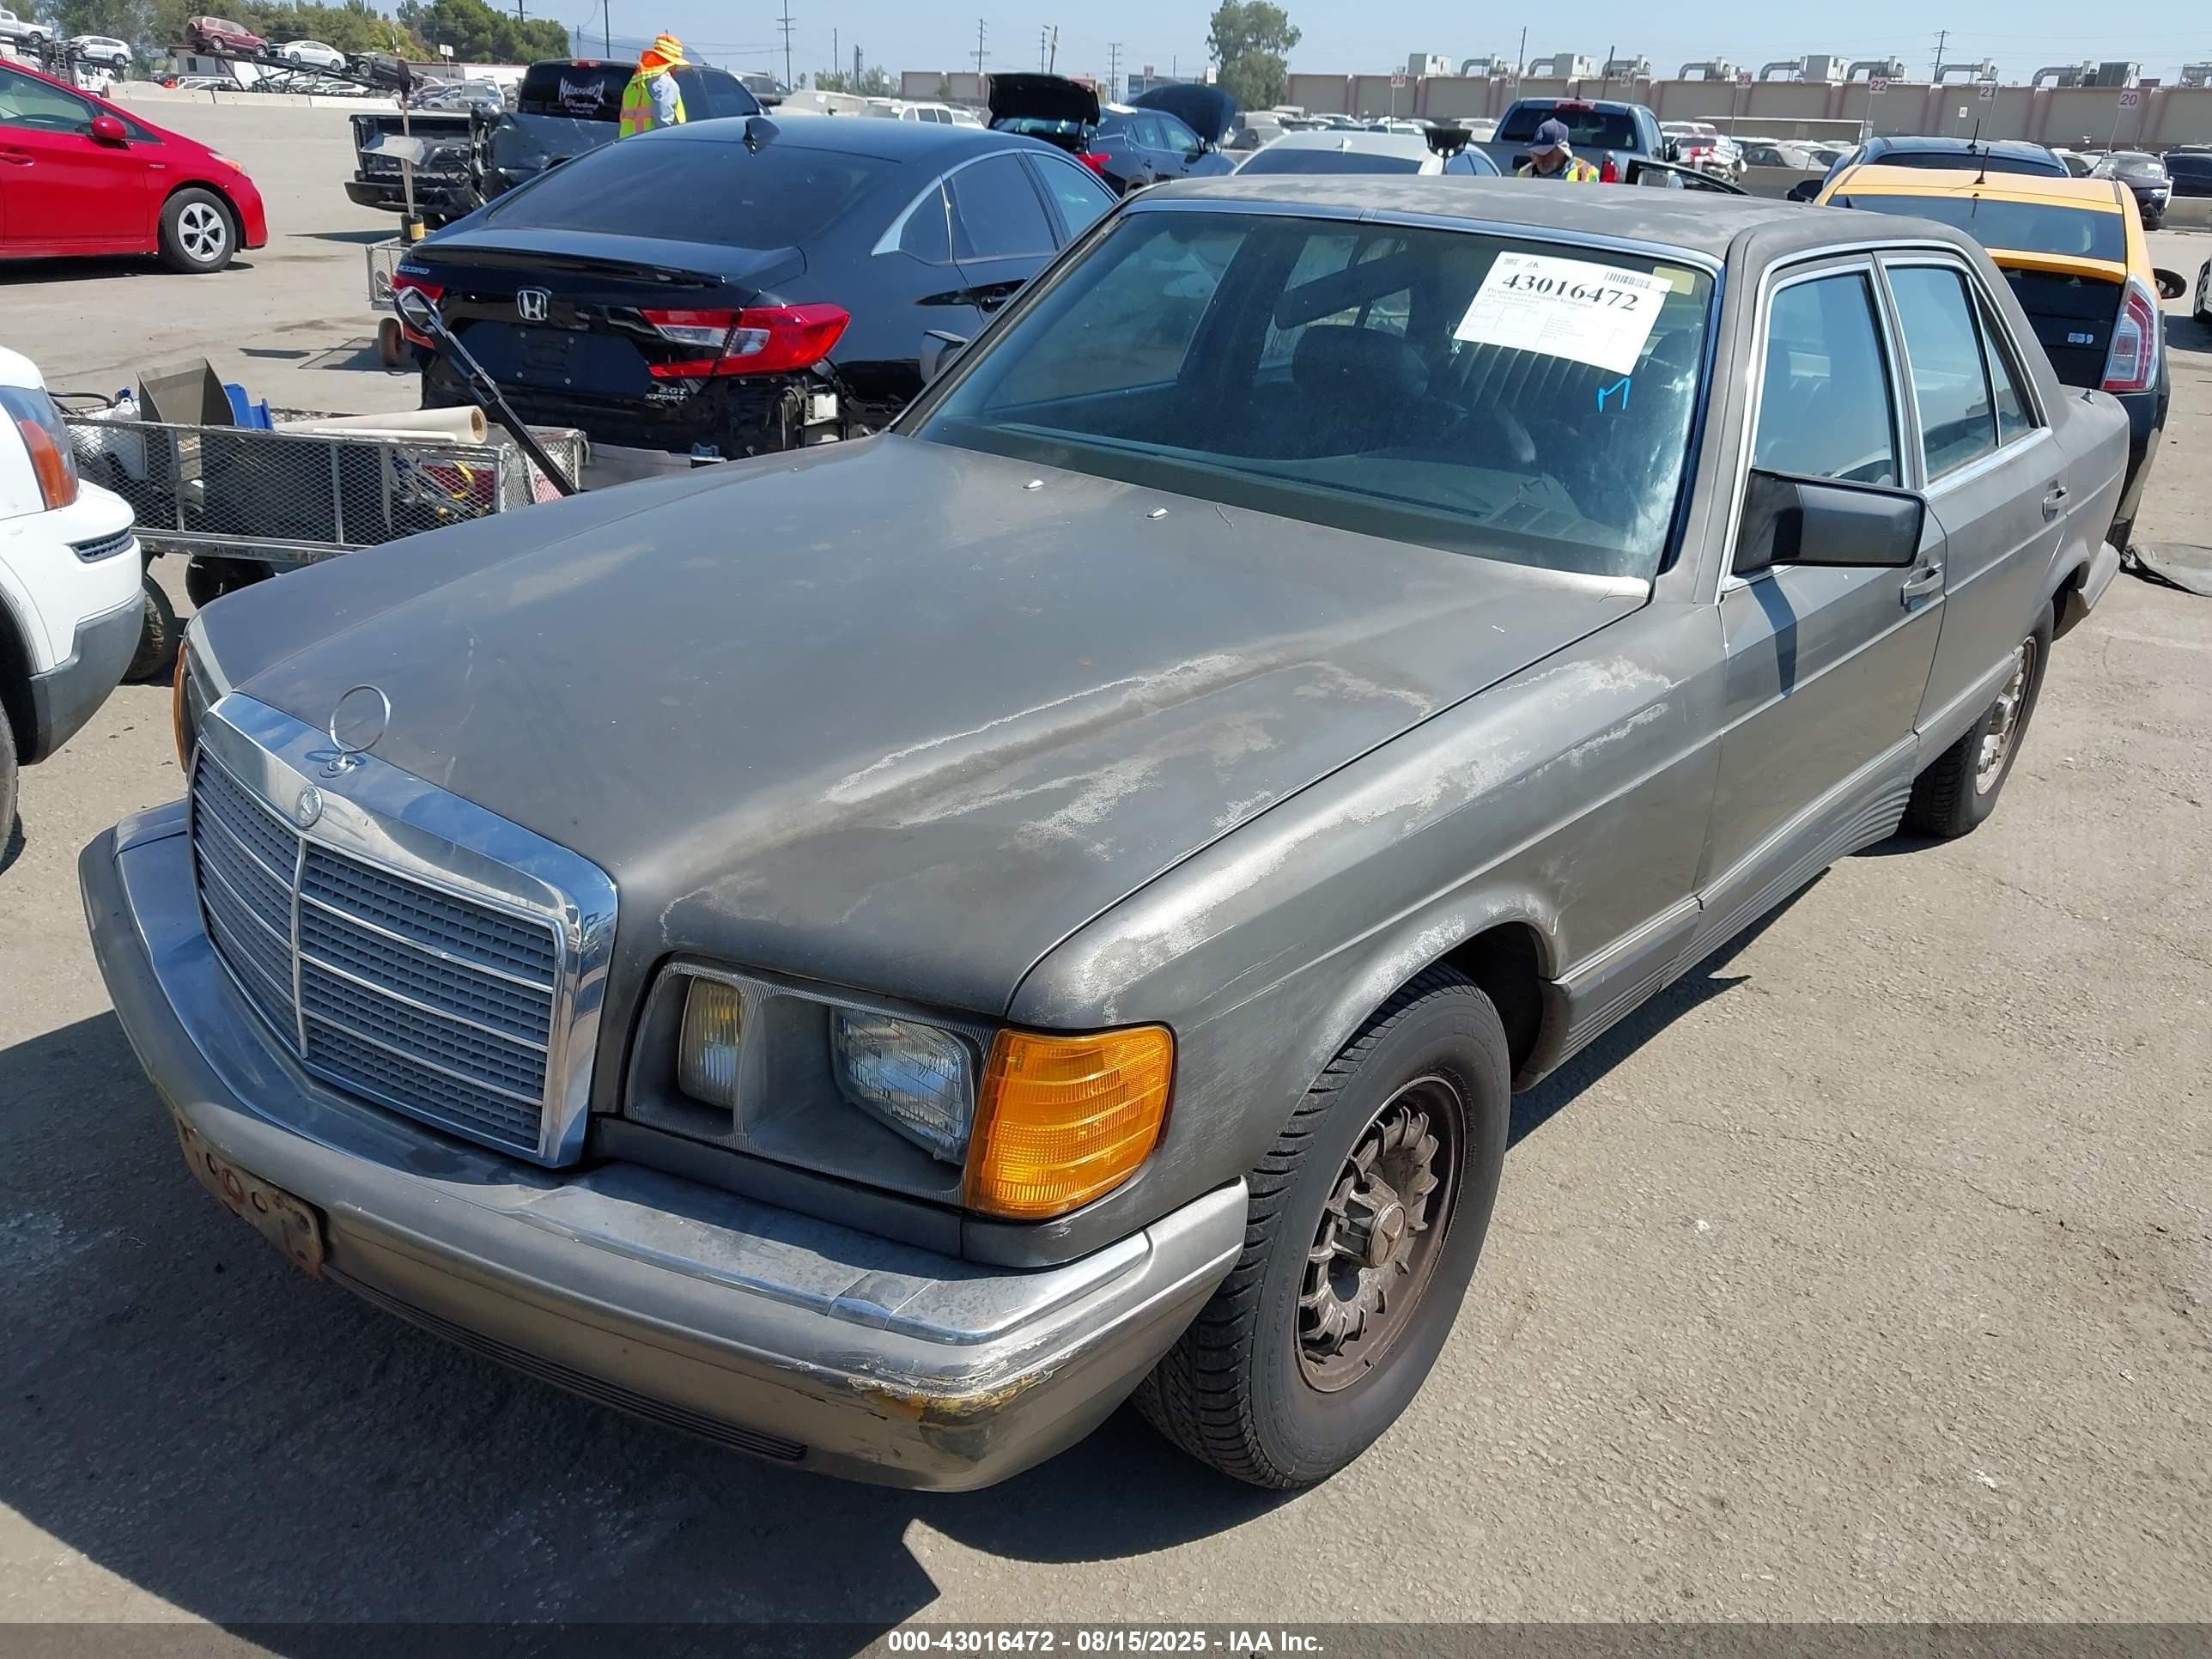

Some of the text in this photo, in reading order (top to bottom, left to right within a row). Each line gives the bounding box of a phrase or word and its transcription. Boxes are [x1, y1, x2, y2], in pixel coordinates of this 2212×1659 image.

[1870, 81, 1887, 91] 22
[2119, 94, 2137, 106] 20
[1502, 273, 1639, 312] 43016472
